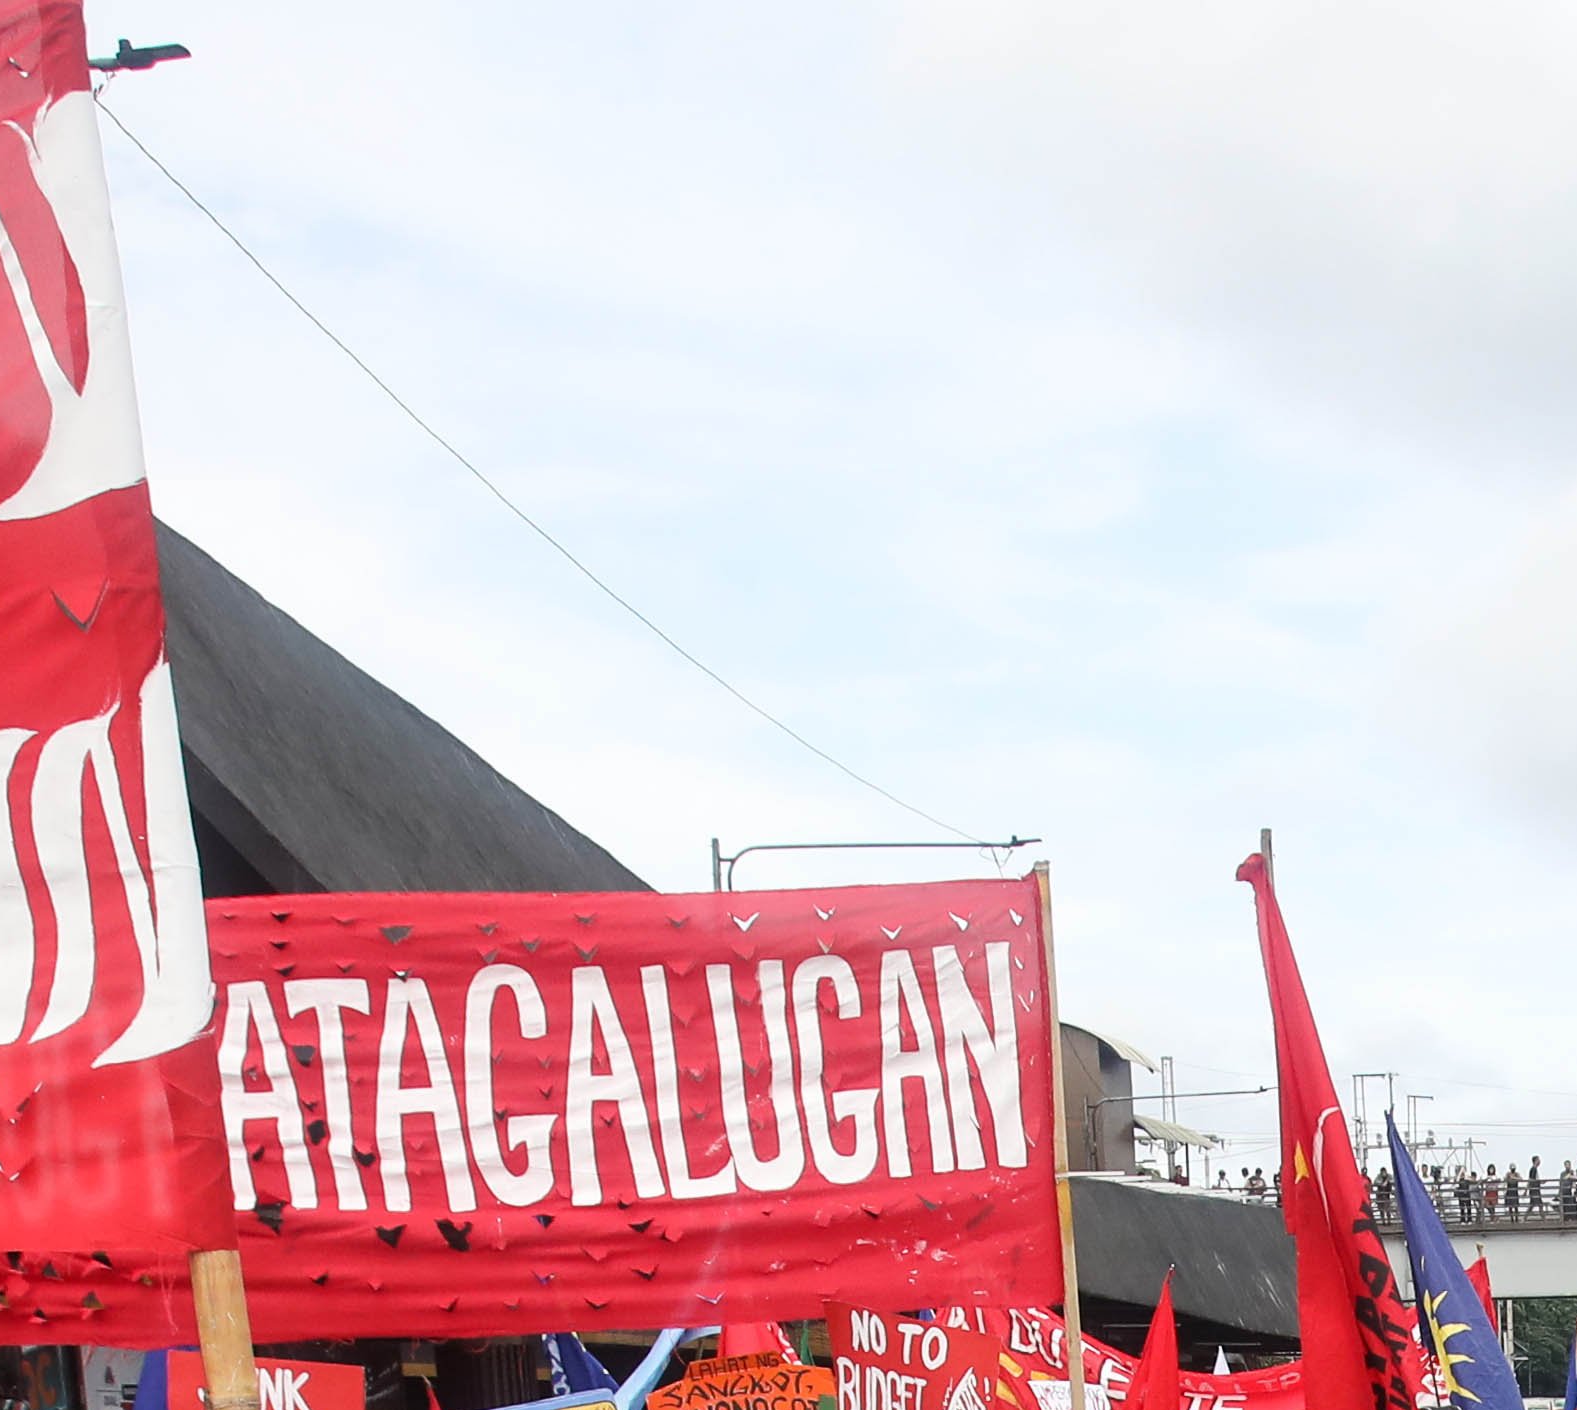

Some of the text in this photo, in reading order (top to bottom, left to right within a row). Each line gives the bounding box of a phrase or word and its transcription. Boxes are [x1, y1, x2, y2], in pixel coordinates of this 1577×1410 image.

[851, 1309, 949, 1370] NO TO
[689, 1353, 780, 1380] LAHAT NG
